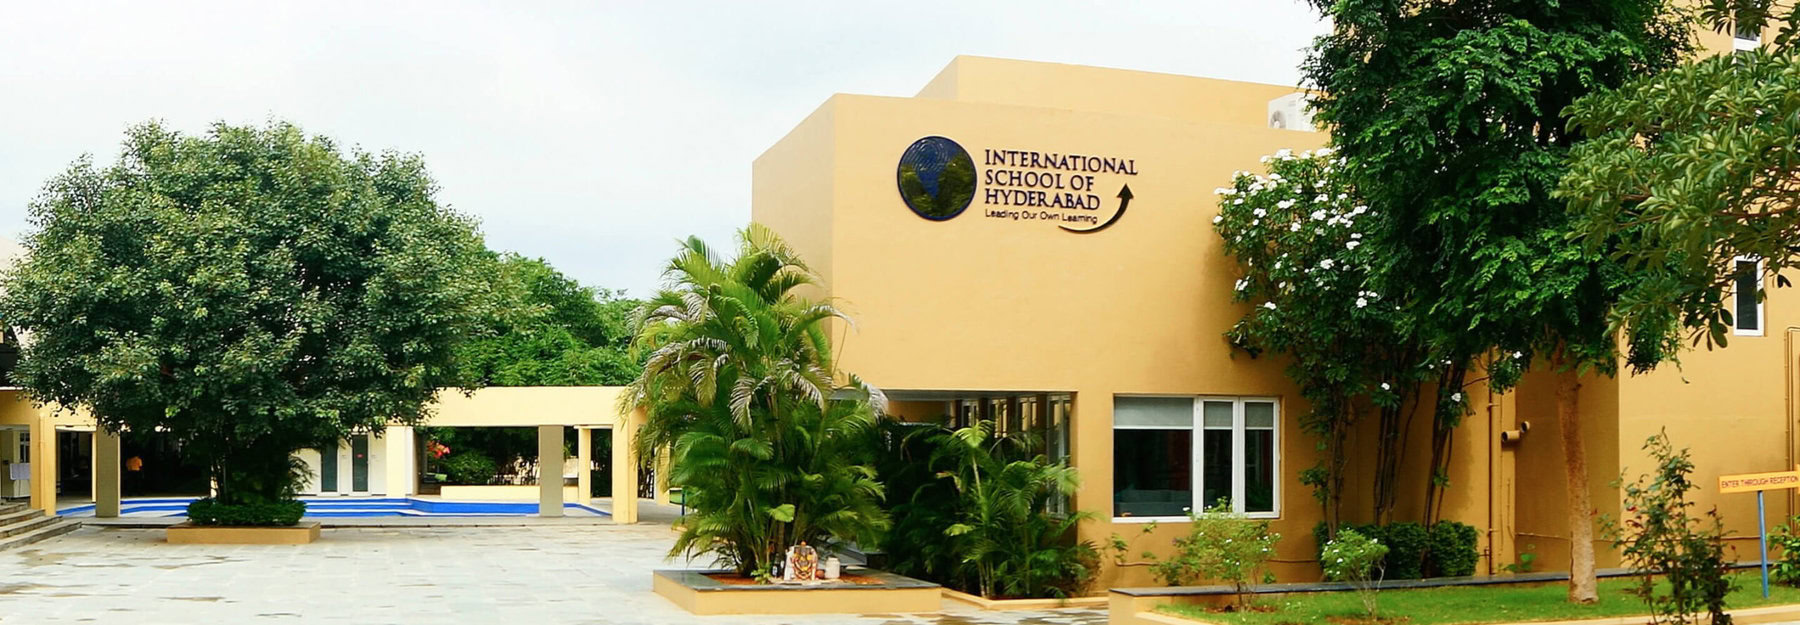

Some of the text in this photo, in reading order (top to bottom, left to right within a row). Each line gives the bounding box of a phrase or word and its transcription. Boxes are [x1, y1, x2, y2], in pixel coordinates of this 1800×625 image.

[985, 149, 1138, 175] INTERNATIONAL
[985, 170, 1095, 191] SCHOOL OF
[985, 189, 1100, 210] HYDERABAD
[985, 209, 1098, 224] Leading Our Own Learning
[1722, 480, 1739, 488] ENTER
[1741, 478, 1768, 486] THROUGH
